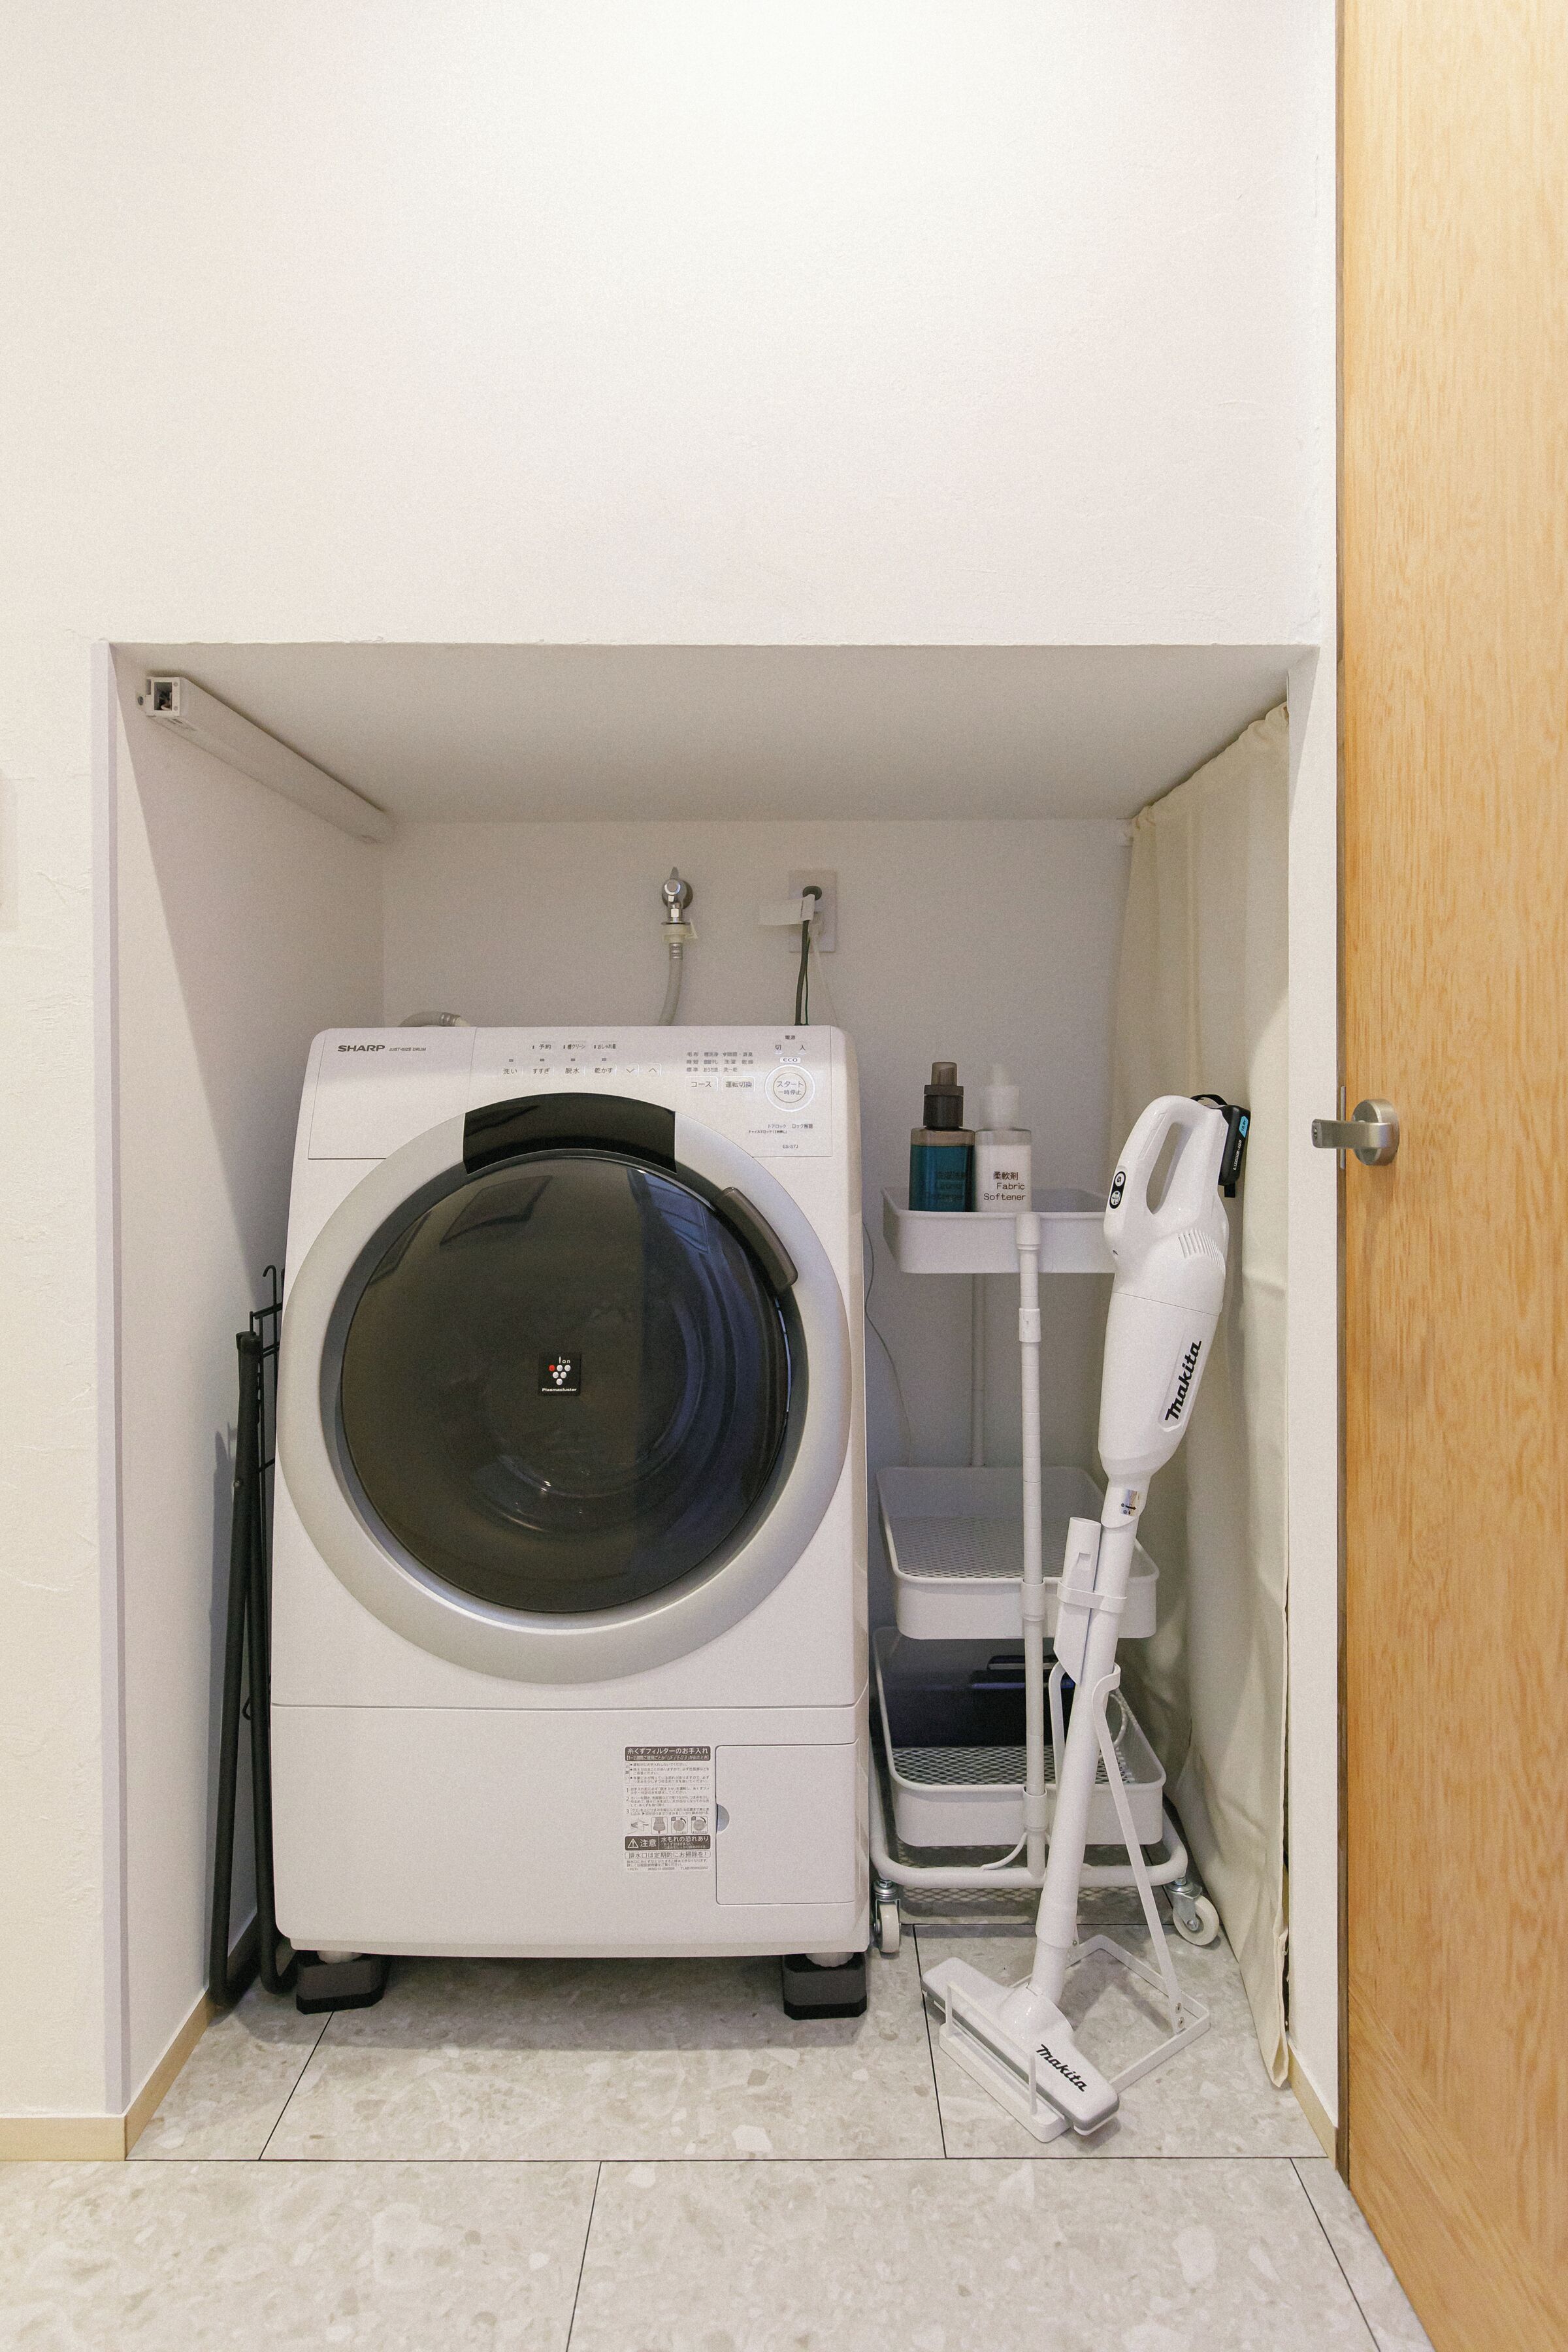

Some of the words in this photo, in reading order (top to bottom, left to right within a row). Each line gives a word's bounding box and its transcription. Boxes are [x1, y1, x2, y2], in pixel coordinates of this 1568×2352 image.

[993, 1171, 1019, 1181] 柔軟剤
[640, 1838, 657, 1848] 注意
